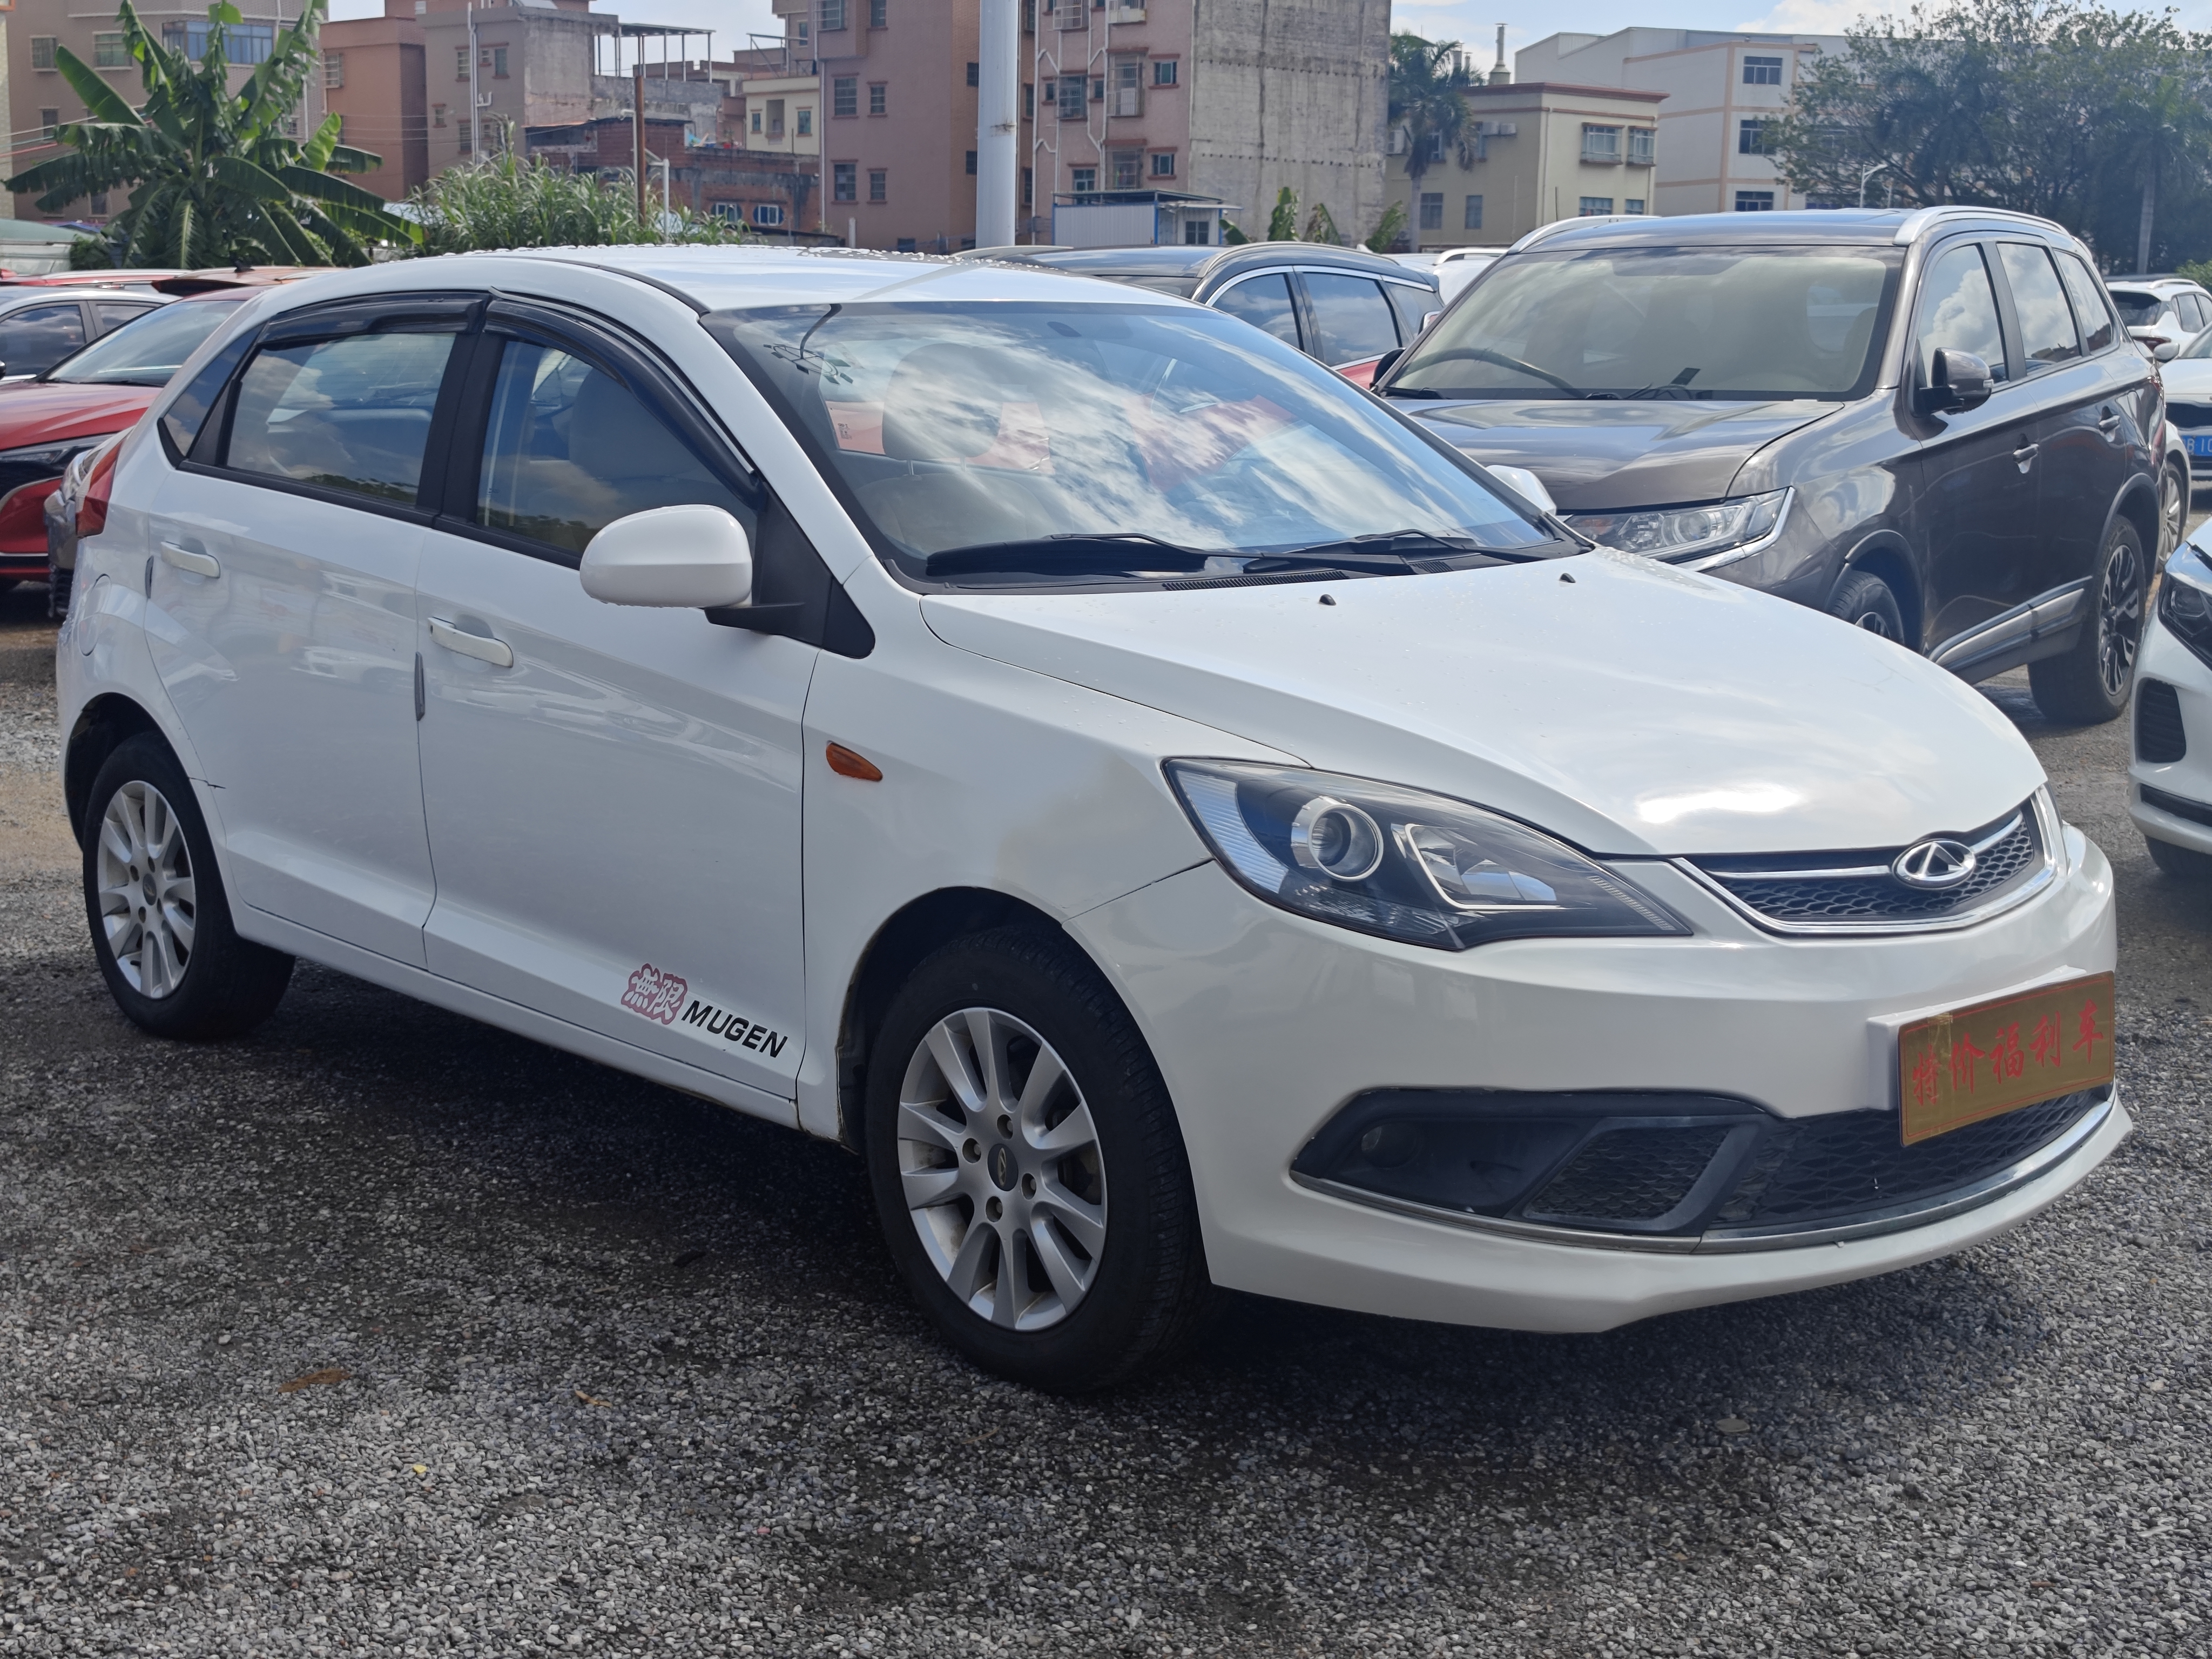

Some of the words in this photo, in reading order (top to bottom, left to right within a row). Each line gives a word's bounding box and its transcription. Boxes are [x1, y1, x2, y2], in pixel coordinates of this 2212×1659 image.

[681, 1000, 788, 1058] MUGEN
[1912, 999, 2103, 1106] 特价福利车
